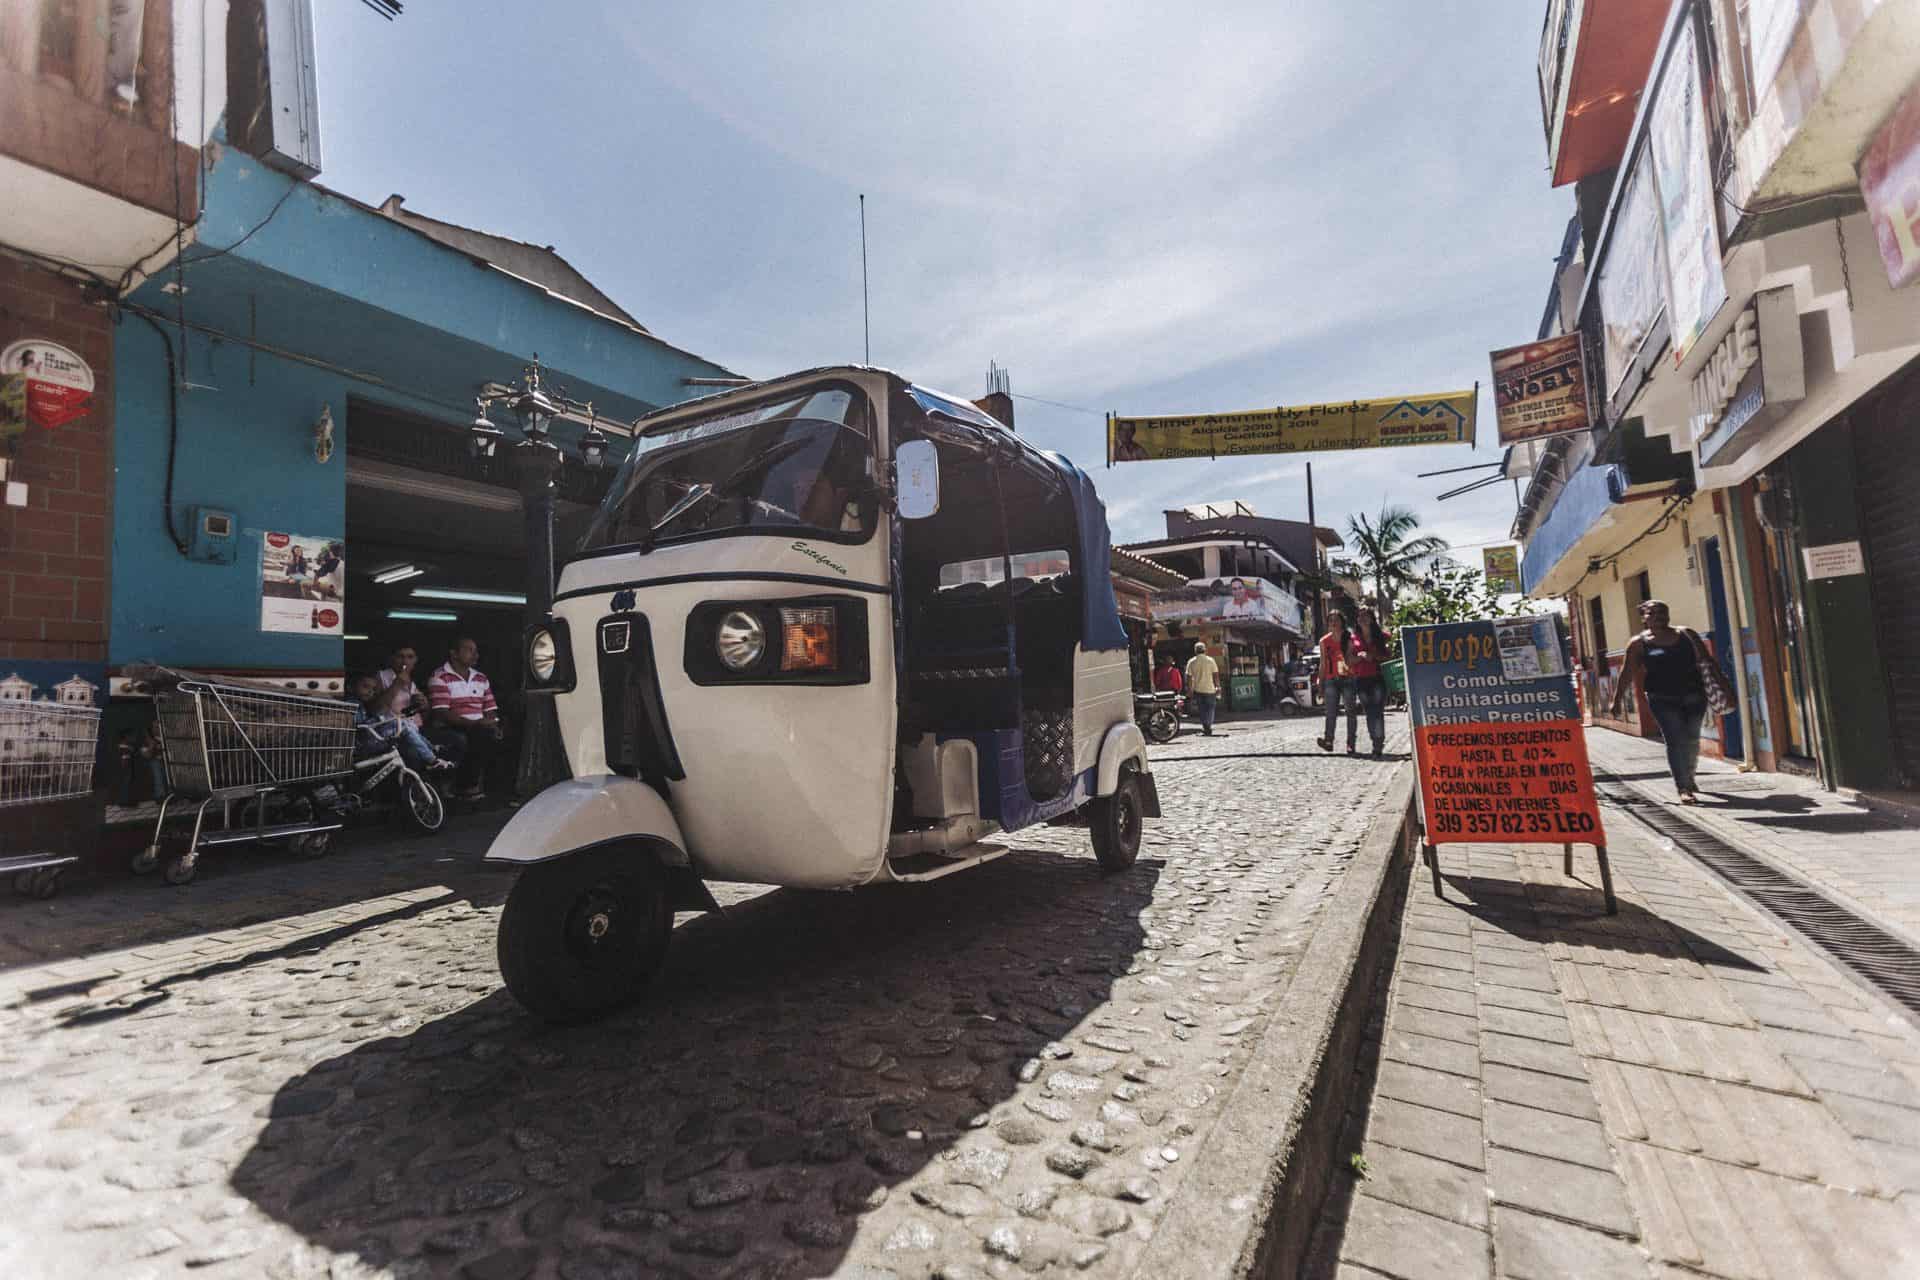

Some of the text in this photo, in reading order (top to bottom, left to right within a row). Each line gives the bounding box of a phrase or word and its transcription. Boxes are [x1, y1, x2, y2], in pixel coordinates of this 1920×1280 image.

[1416, 630, 1500, 669] Hospe
[1426, 690, 1560, 708] Habitaciones
[1488, 709, 1567, 722] Precios
[1497, 729, 1571, 745] DESCUENTOS
[1461, 749, 1496, 762] HASTA
[1502, 748, 1516, 761] EL
[1523, 748, 1539, 760] 40
[1477, 765, 1517, 777] PAREJA
[1520, 765, 1536, 777] EN
[1540, 762, 1576, 777] MOTO
[1433, 782, 1512, 795] OCASIONALES
[1521, 782, 1529, 794] Y
[1435, 798, 1449, 810] DE
[1452, 798, 1491, 811] LUNES
[1503, 798, 1560, 811] VIERNES
[1435, 812, 1595, 833] 319 357 82 35 LEO
